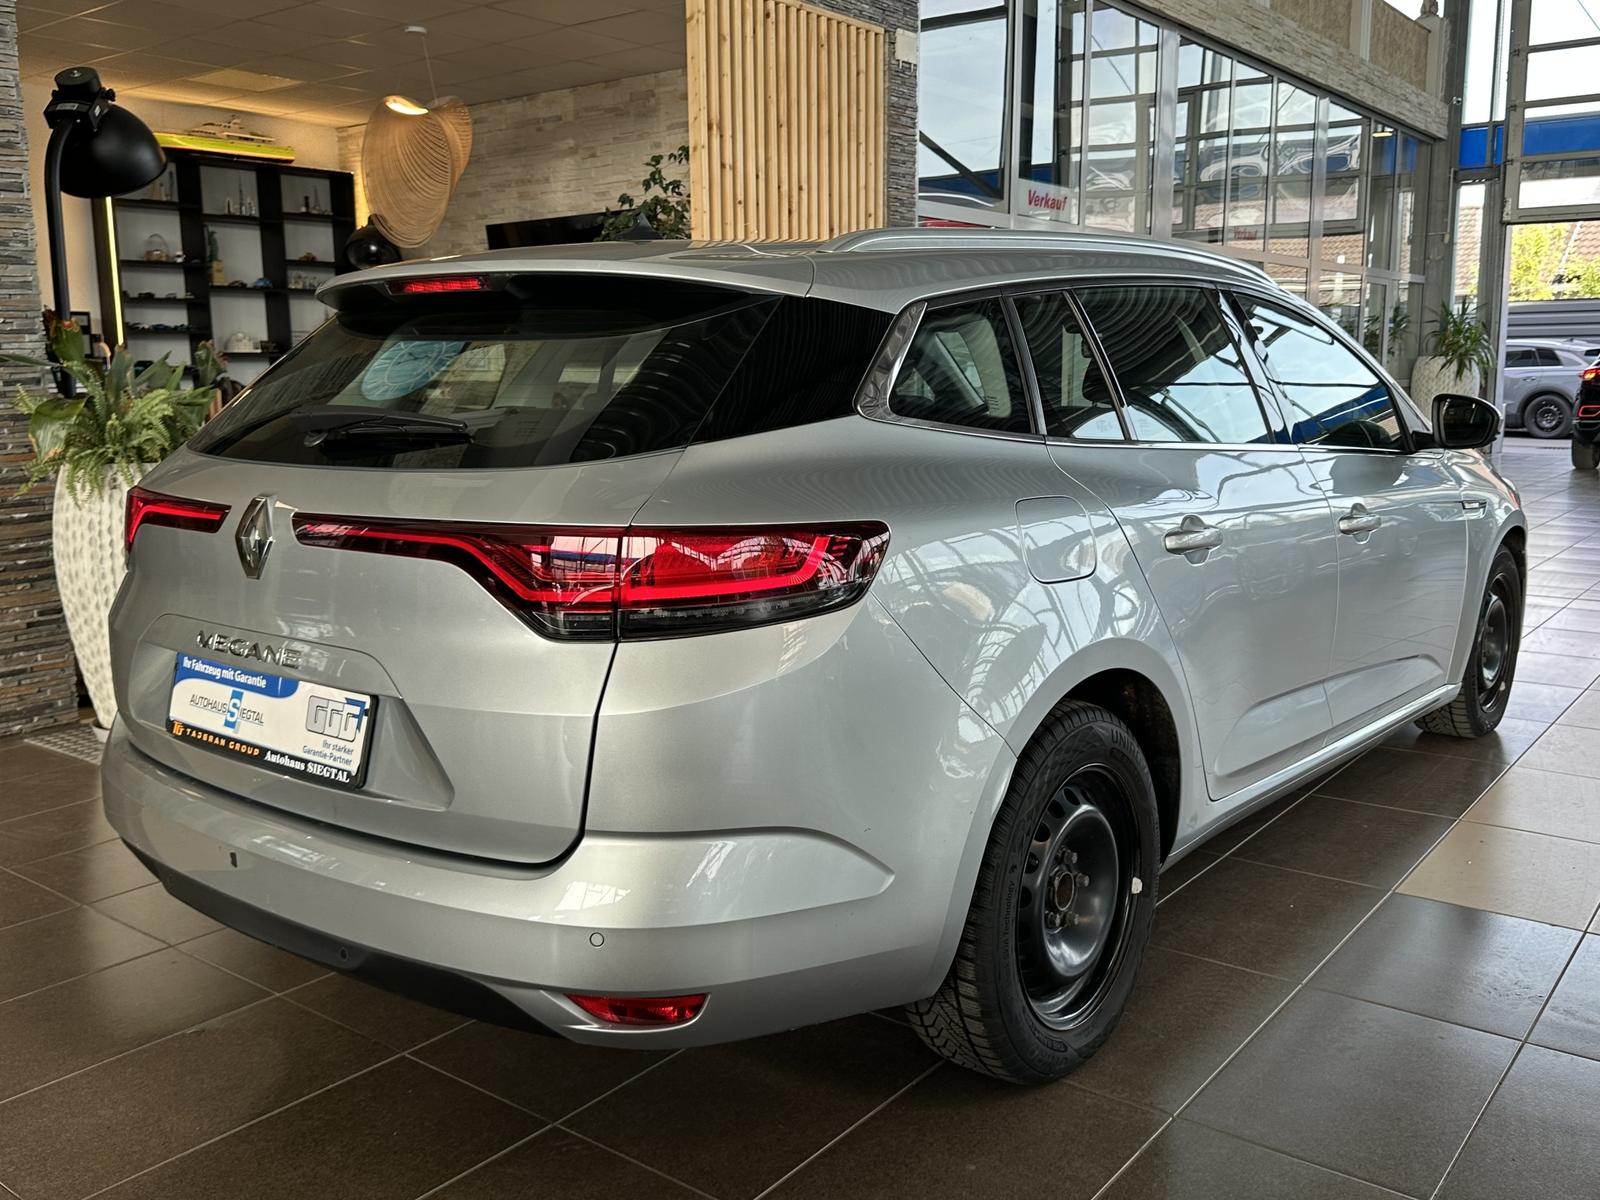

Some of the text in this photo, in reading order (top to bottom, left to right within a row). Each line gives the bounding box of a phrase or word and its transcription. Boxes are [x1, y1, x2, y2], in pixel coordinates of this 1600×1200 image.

[1028, 189, 1068, 211] Verkauf
[196, 630, 303, 670] MEGANE
[183, 656, 267, 688] Ihr Fahrzeug mit Garantie
[190, 694, 228, 713] AUTOHAUS
[228, 741, 260, 756] GROUP
[303, 745, 352, 766] Garantie-Partner
[322, 740, 354, 756] Ihr starker
[264, 751, 350, 783] Autohaus SIEGTAL
